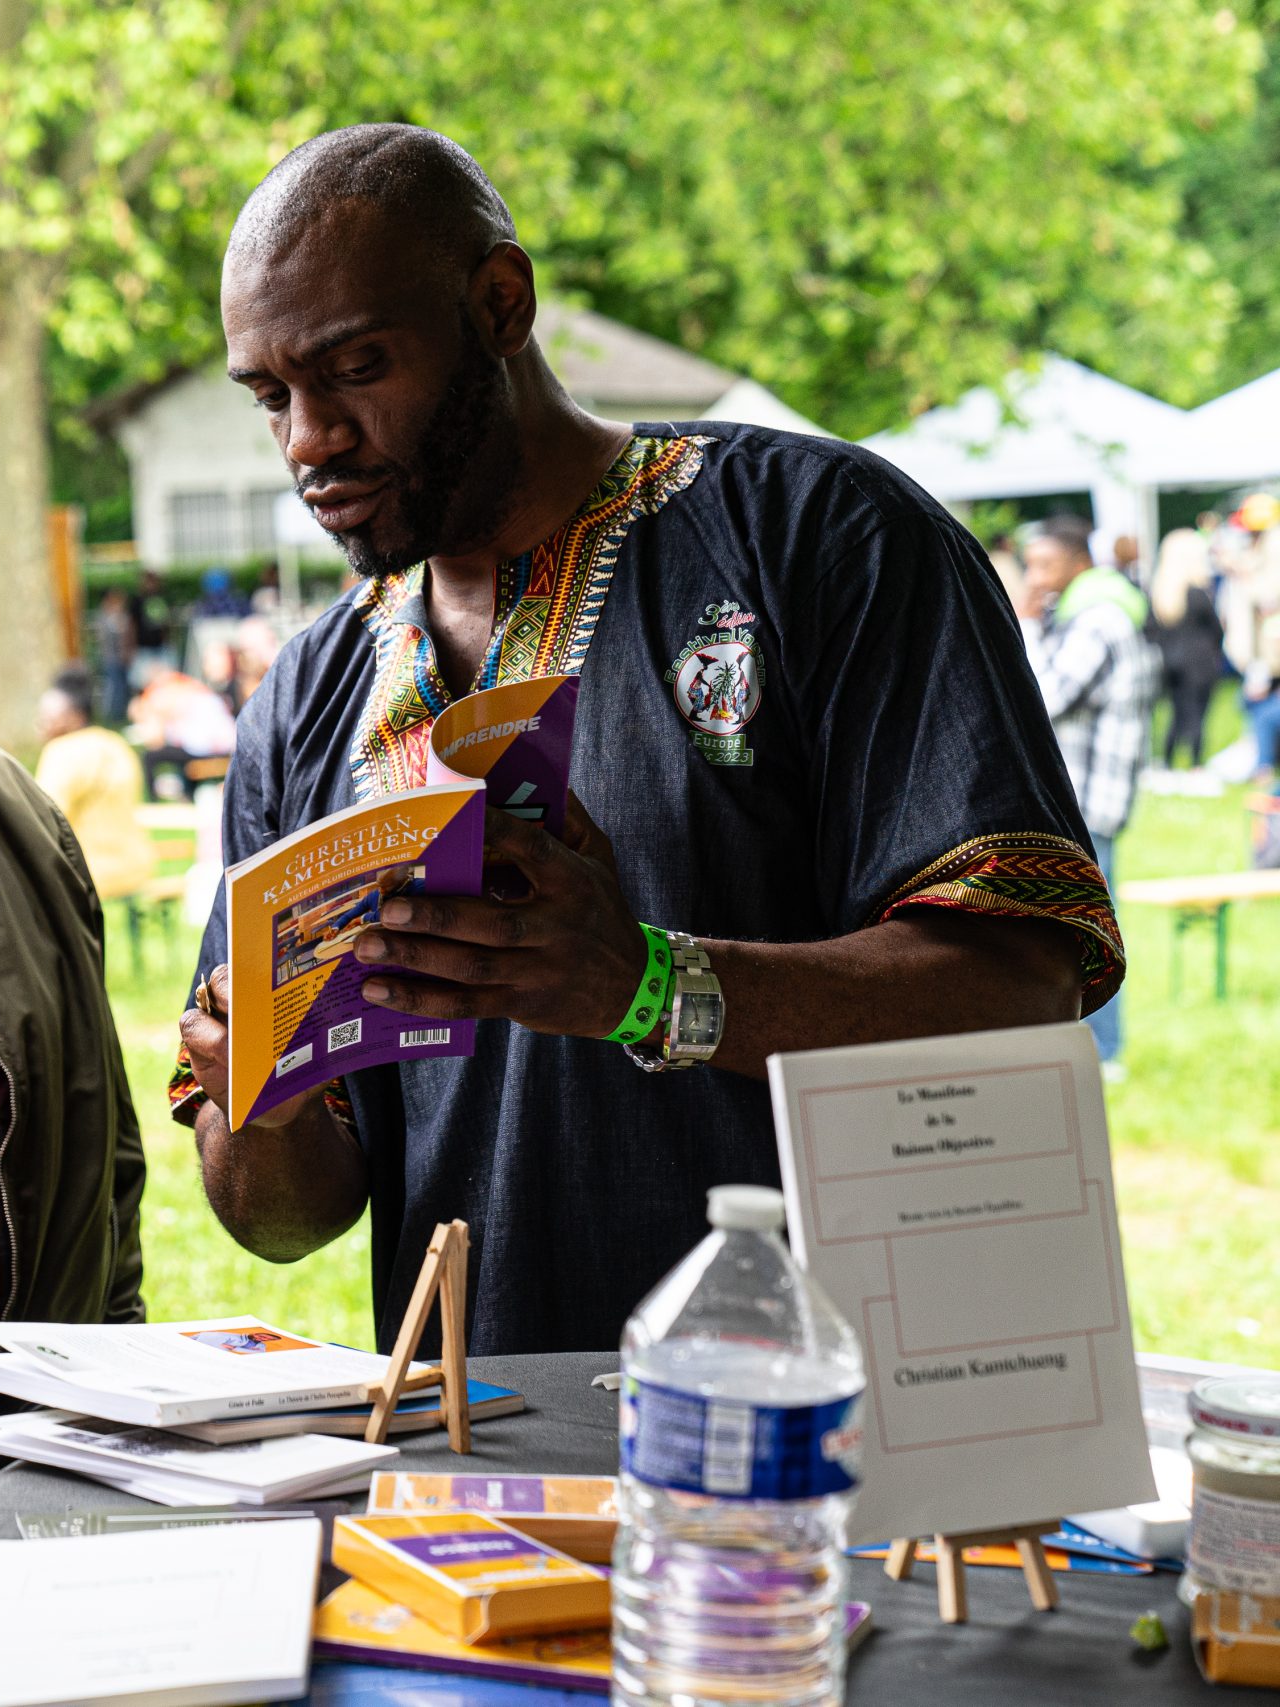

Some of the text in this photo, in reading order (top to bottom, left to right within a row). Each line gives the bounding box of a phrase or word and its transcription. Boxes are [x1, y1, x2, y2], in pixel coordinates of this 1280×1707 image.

[693, 733, 741, 750] Europe
[715, 751, 750, 763] 2023
[262, 826, 439, 905] KAMTCHUENG
[285, 816, 412, 875] CHRISTIAN
[287, 851, 413, 904] AUTEUR PLURIDISCIPLINAIRE
